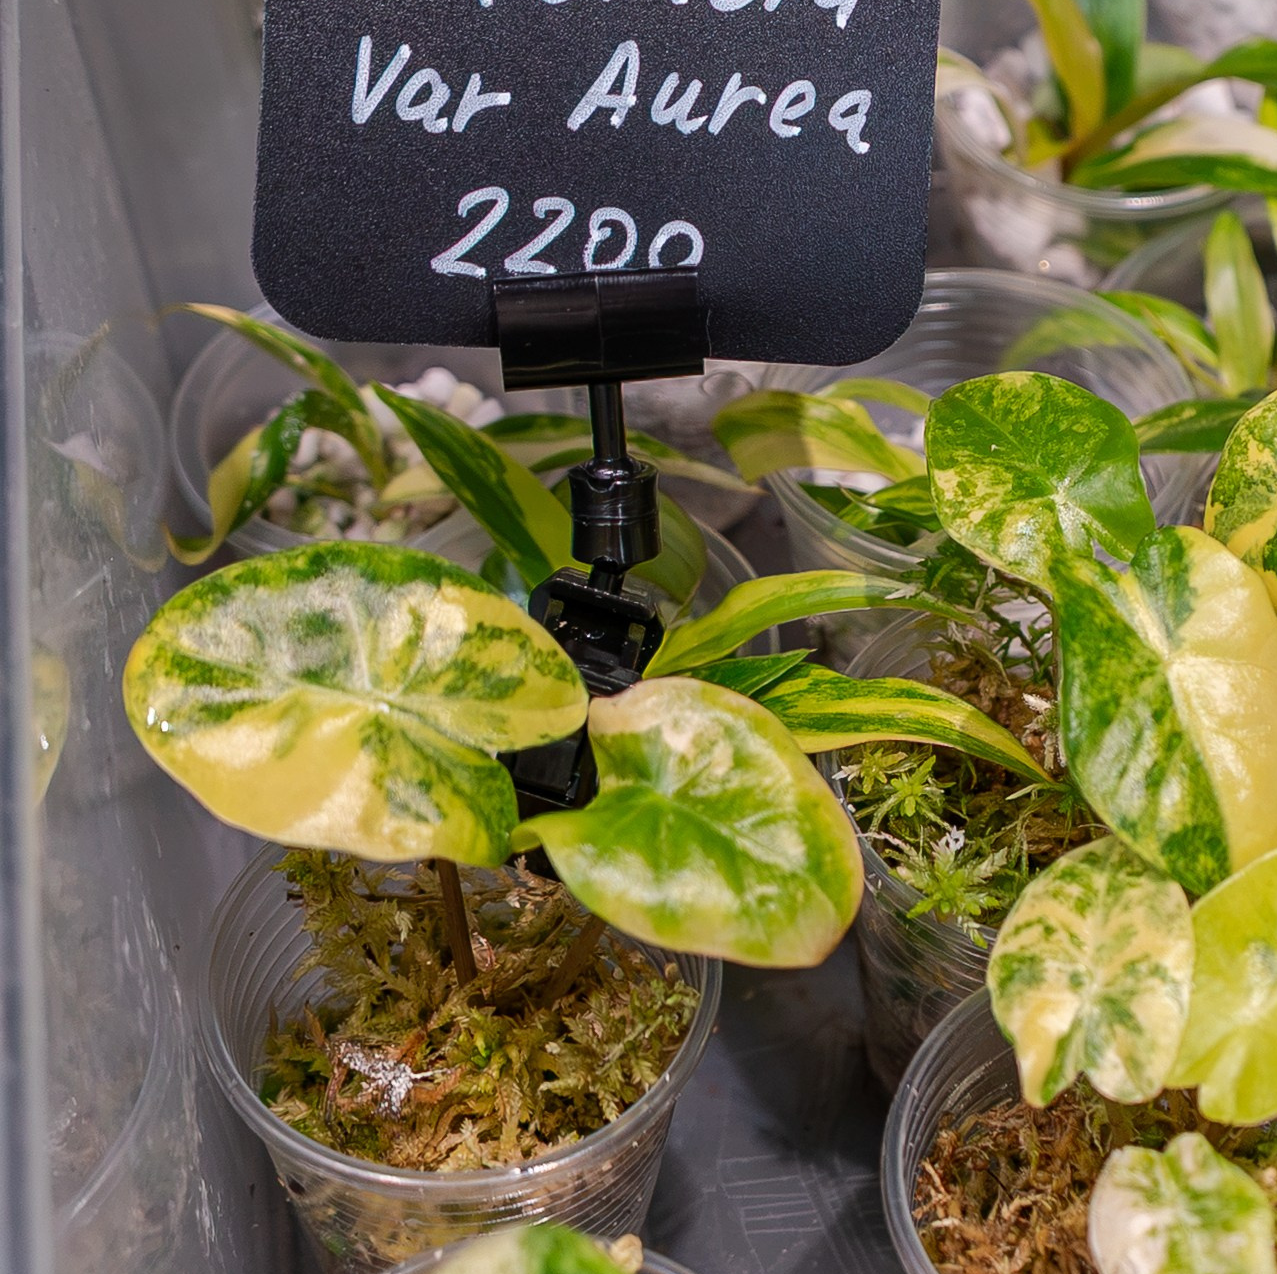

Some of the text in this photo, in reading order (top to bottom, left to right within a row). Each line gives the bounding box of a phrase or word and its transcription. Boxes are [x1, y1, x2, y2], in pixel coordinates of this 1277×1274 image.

[351, 35, 873, 154] Var Aurea
[430, 186, 705, 278] 2200
